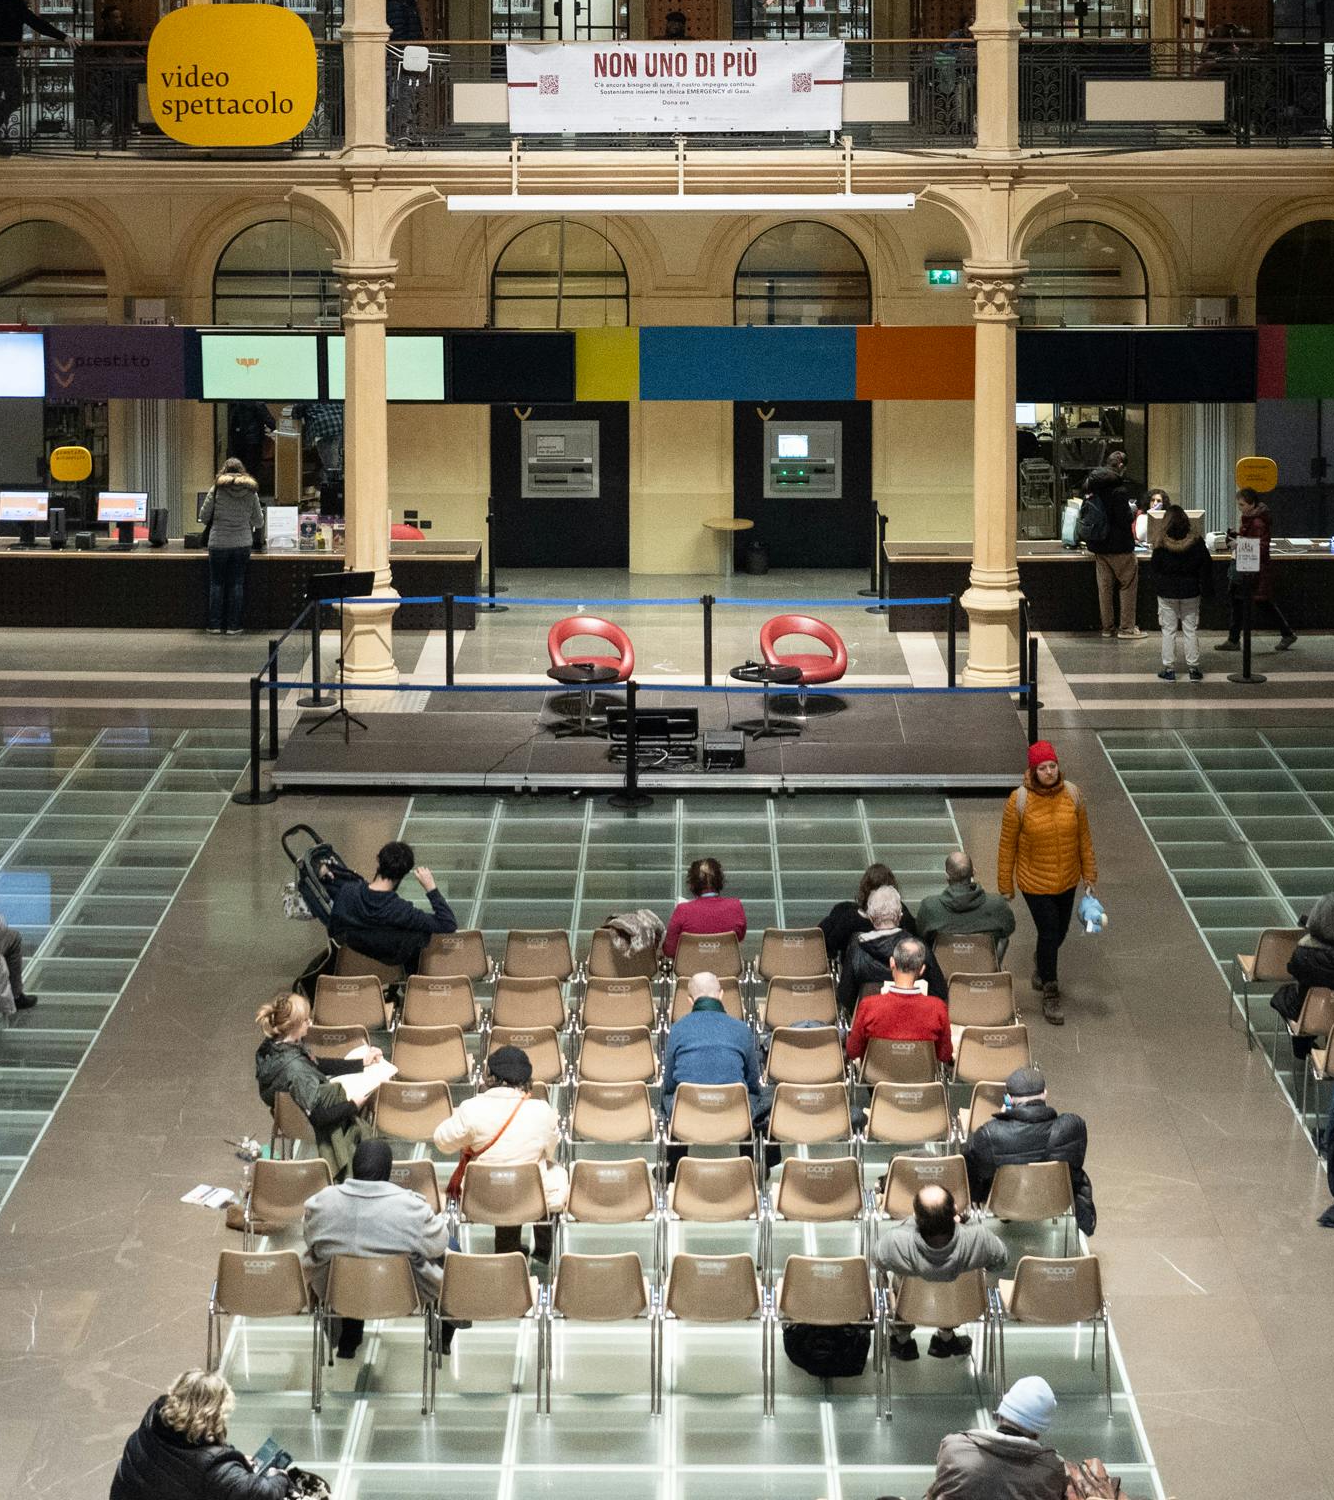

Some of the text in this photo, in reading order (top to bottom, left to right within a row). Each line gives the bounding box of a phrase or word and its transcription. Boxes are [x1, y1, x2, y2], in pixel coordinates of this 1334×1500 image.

[161, 65, 229, 88] video
[594, 47, 757, 78] NON UNO DI PIÙ
[161, 91, 293, 123] spettacolo
